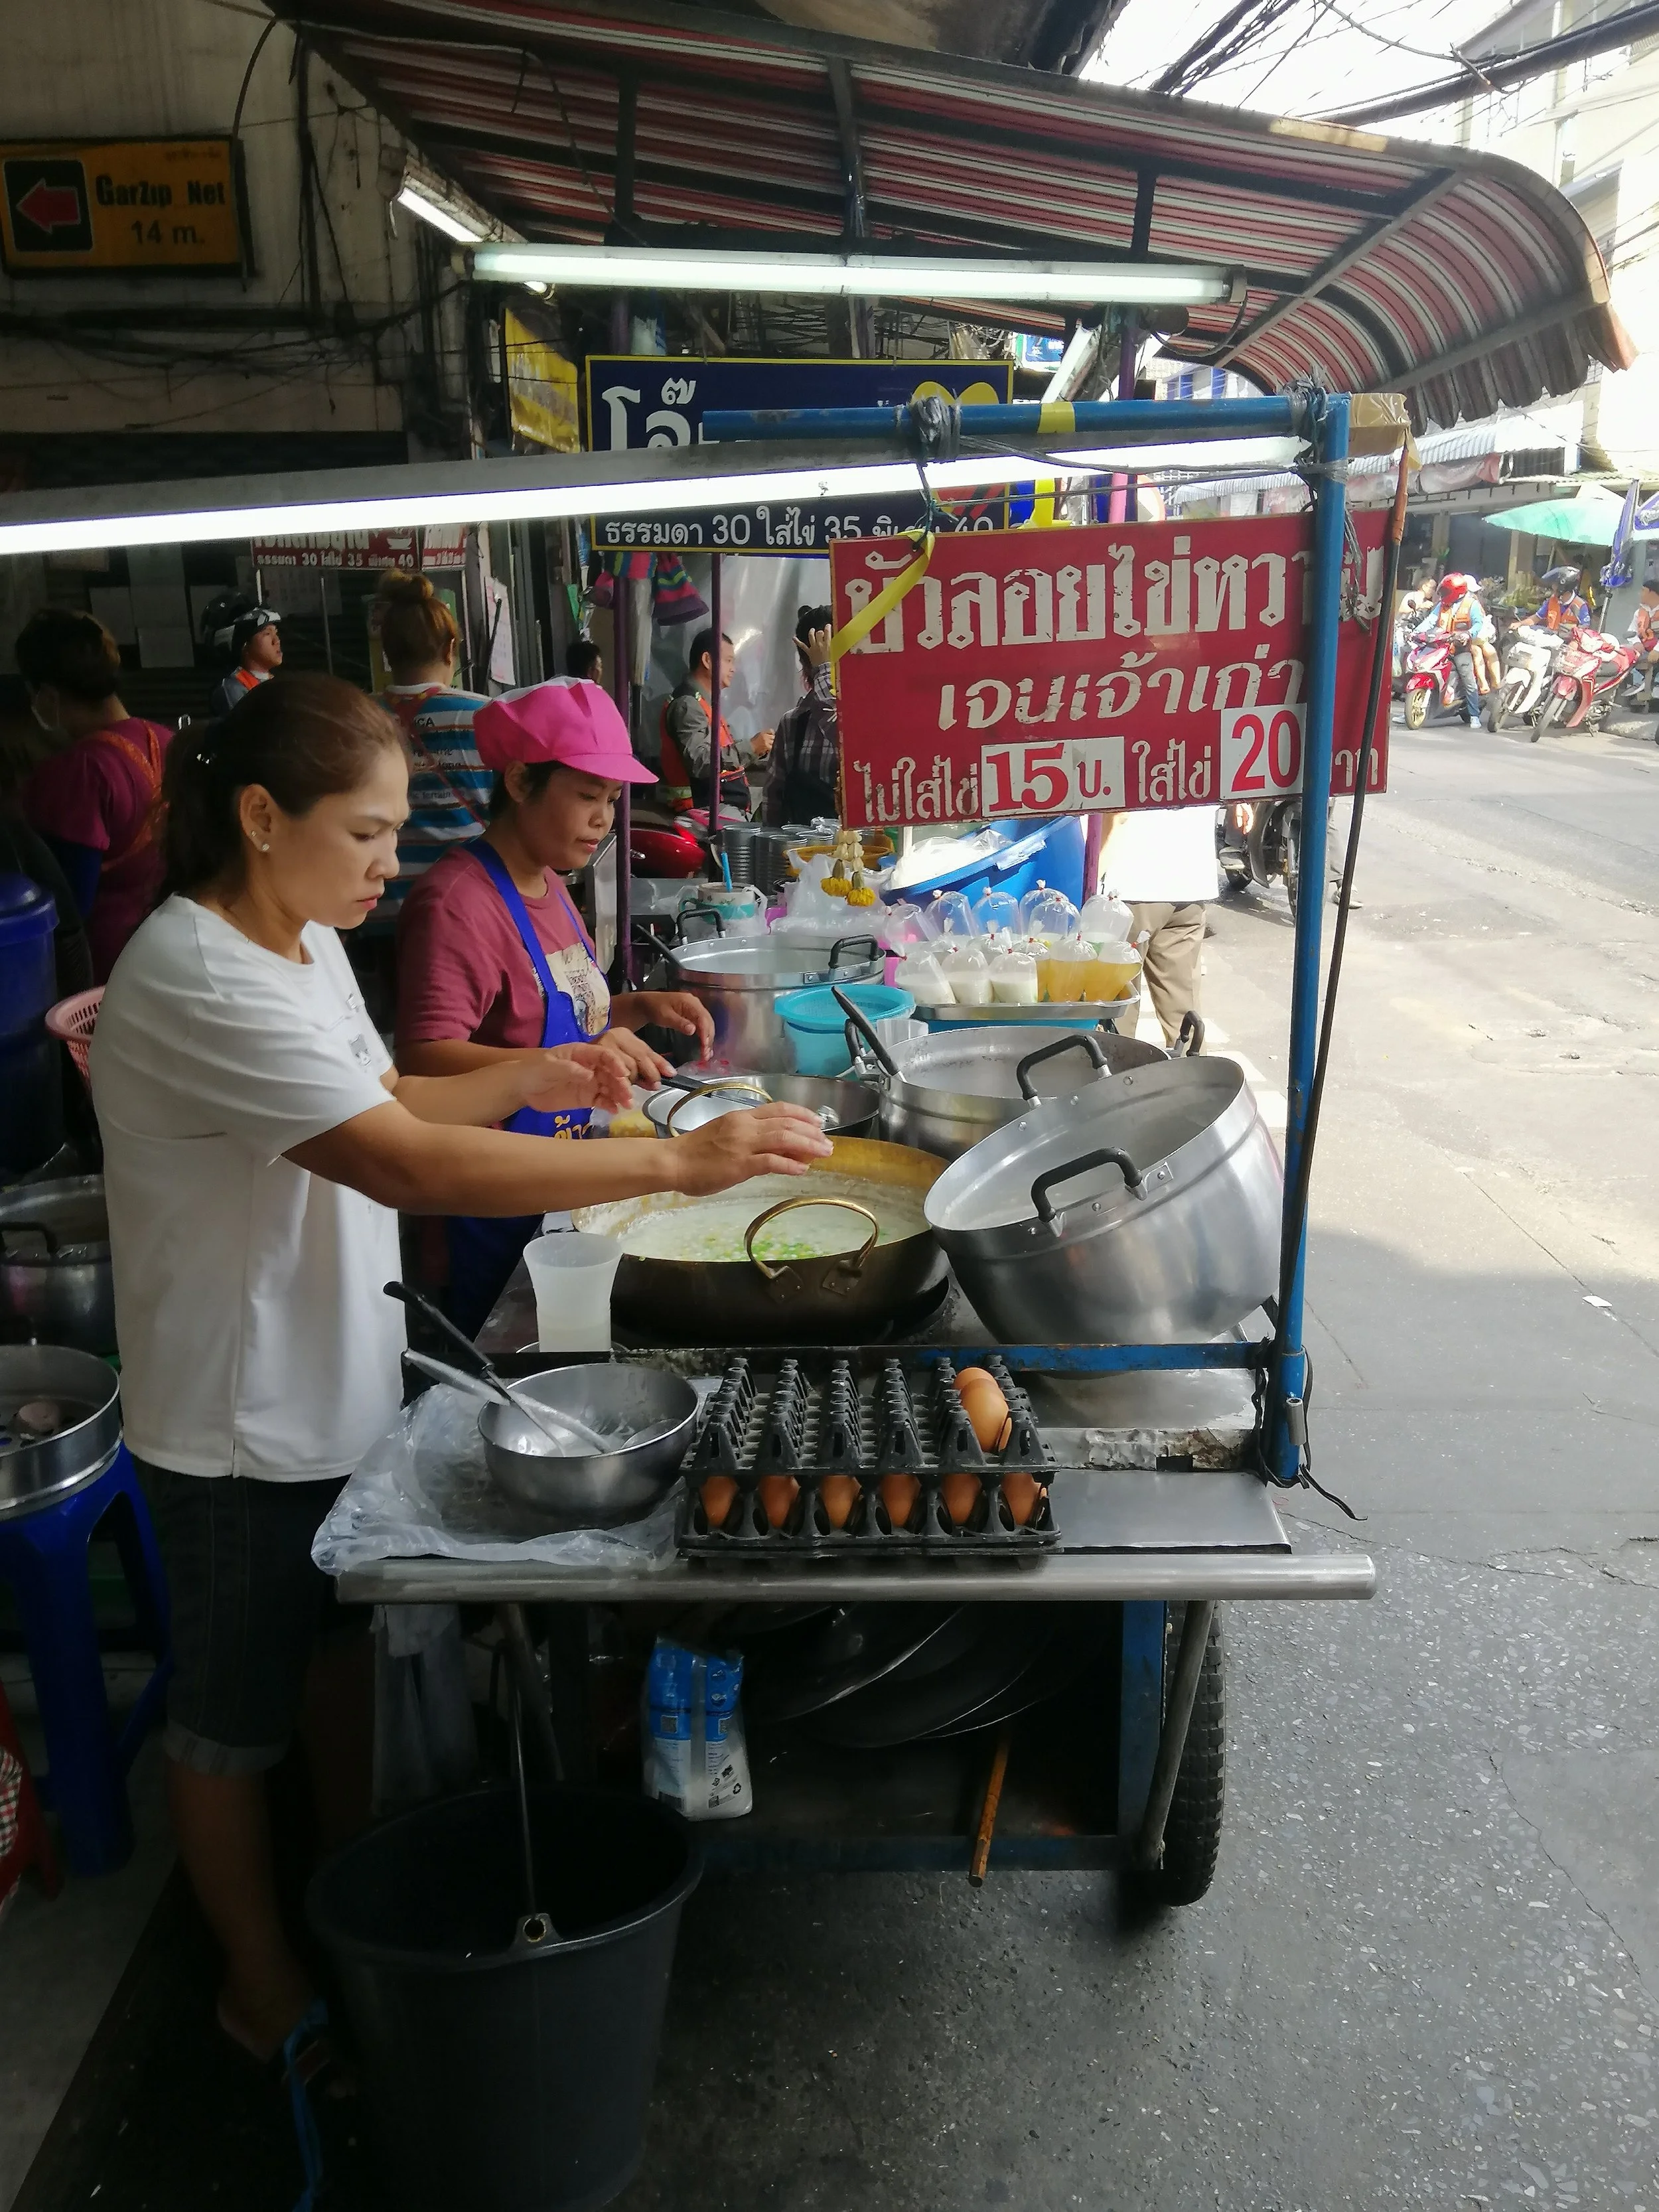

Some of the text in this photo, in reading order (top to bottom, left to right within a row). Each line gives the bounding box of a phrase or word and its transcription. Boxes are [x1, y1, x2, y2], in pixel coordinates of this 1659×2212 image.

[131, 220, 162, 244] 14
[605, 520, 702, 544] ธรรมดา
[712, 514, 751, 546] 30
[756, 506, 815, 547] ใส่ไข่
[824, 514, 861, 540] 35
[302, 553, 317, 566] 30
[347, 553, 363, 567] 35
[398, 554, 414, 567] 40
[1131, 737, 1212, 804] ใส่ไข่
[1231, 709, 1302, 792] 20
